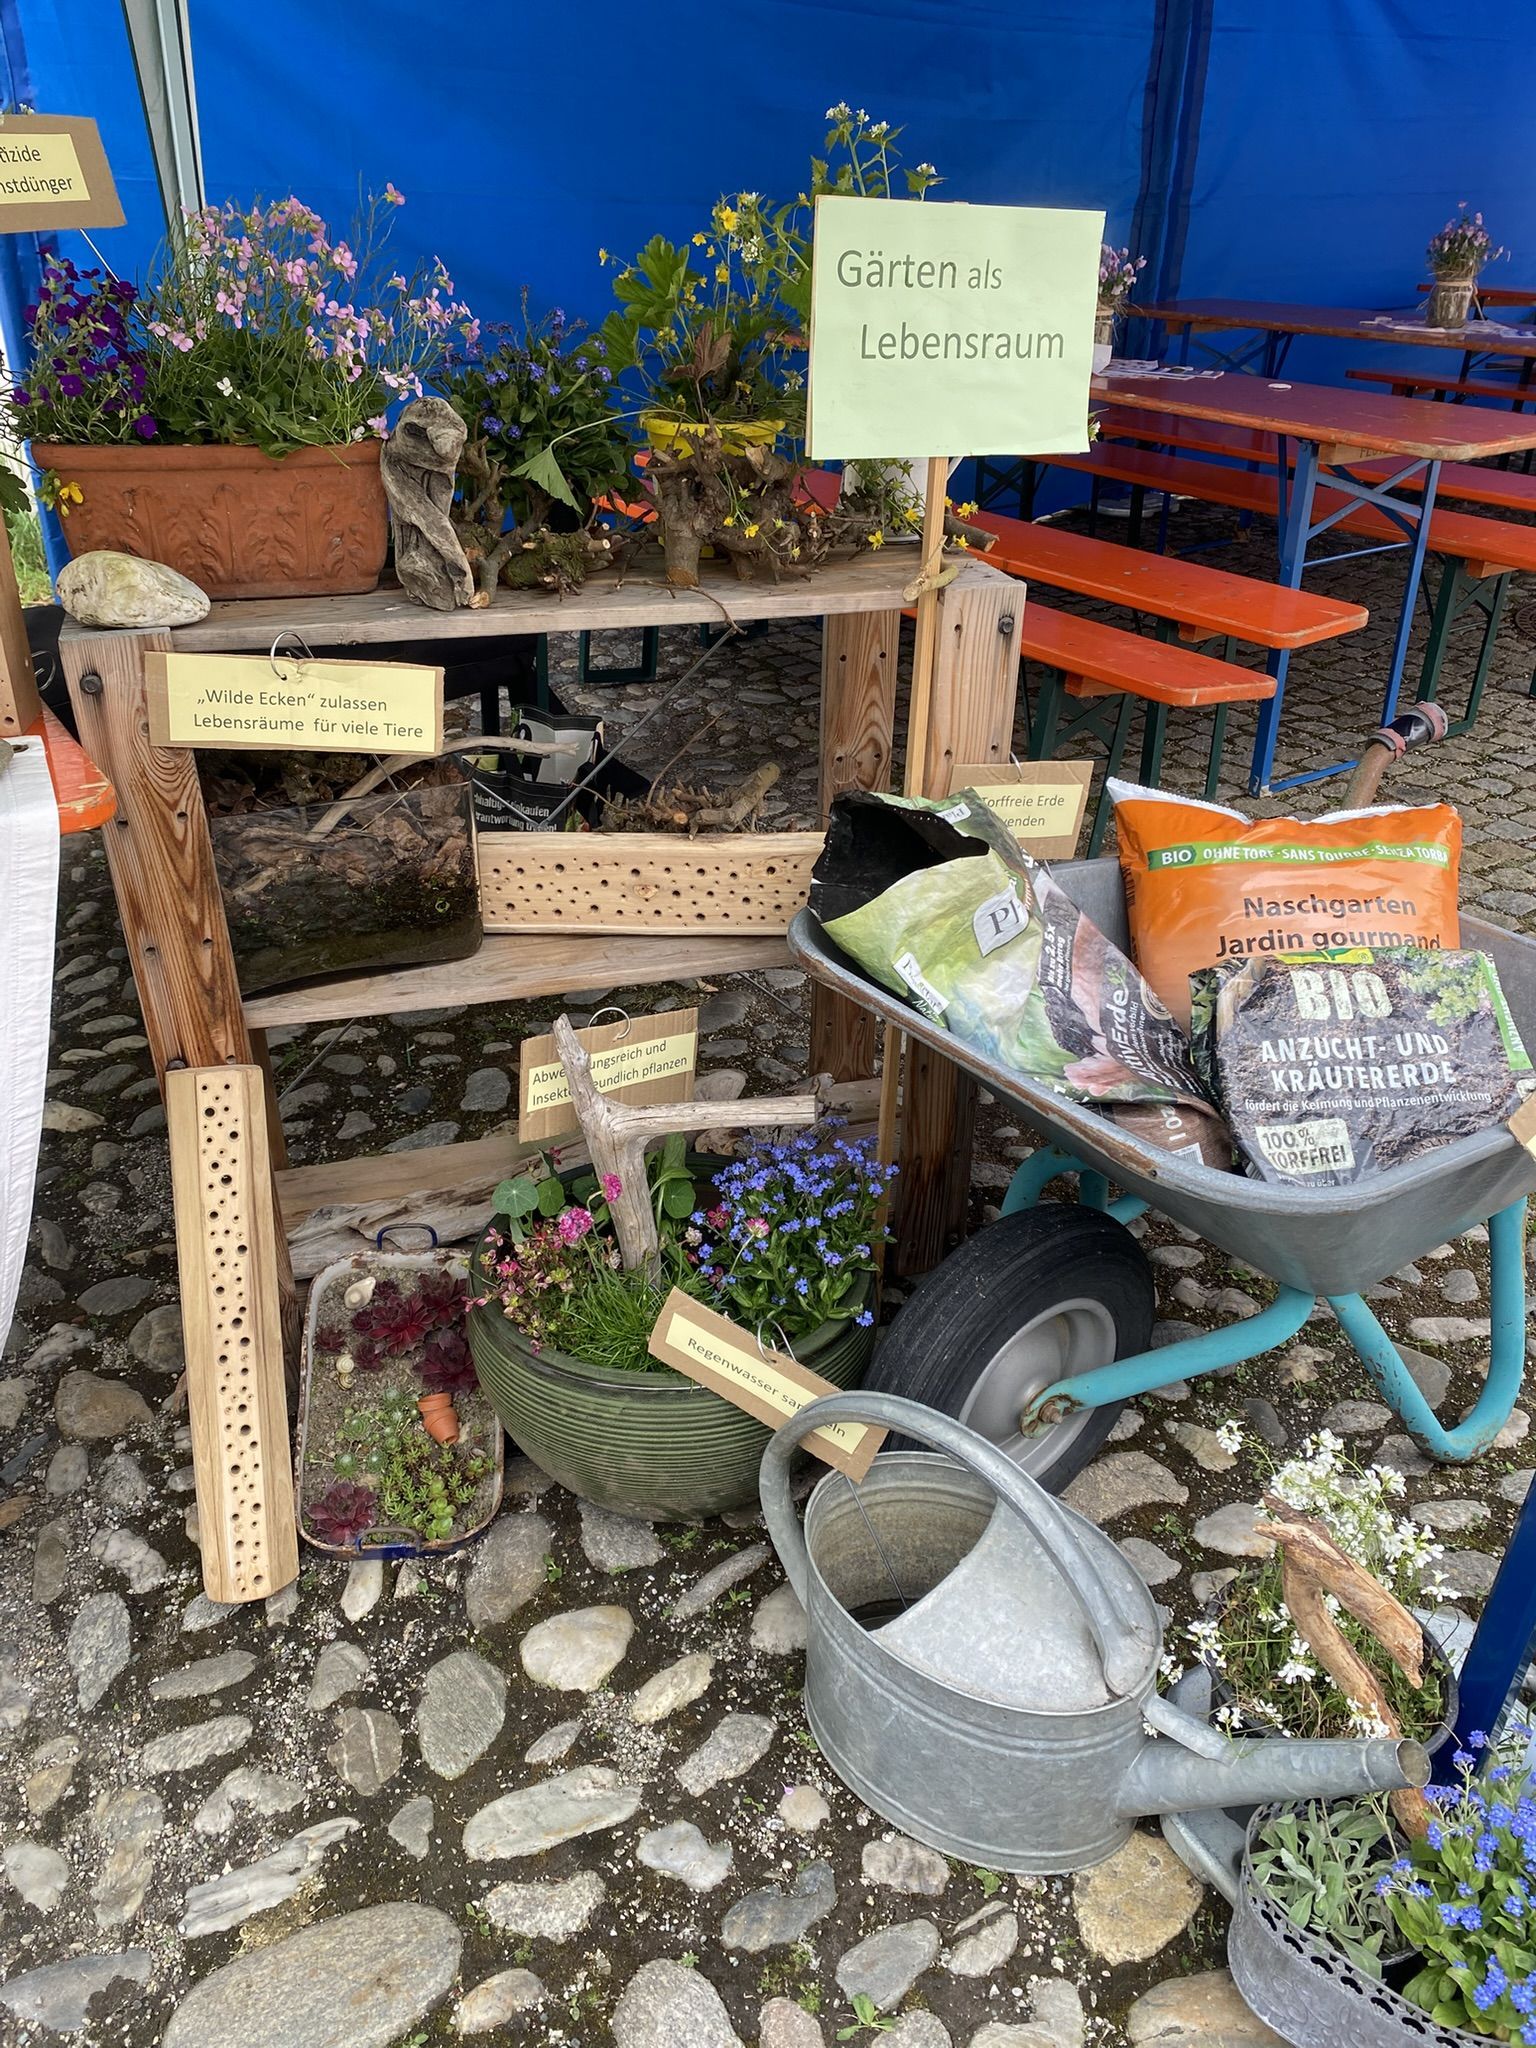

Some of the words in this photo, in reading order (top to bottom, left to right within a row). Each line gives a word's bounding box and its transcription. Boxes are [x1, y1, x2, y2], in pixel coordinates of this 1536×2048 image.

[837, 250, 957, 289] Gärten
[967, 258, 1002, 290] als
[860, 322, 1064, 360] Lebensraum
[197, 688, 253, 705] „Wilde
[259, 691, 315, 707] Ecken“
[320, 695, 387, 712] zulassen
[194, 713, 305, 731] Lebensräume
[314, 718, 337, 733] für
[341, 720, 379, 736] viele
[384, 723, 423, 738] Tiere
[1037, 794, 1065, 807] Erde
[1162, 849, 1192, 865] BIO
[1203, 846, 1240, 860] OHNE
[1243, 847, 1274, 860] TORF
[1282, 848, 1315, 861] SANS
[1415, 847, 1448, 863] TORBA
[1243, 894, 1416, 919] Naschgarten
[1044, 922, 1056, 957] 2,5x
[1216, 929, 1304, 958] Jardin
[1311, 930, 1440, 950] gourmand
[1290, 970, 1393, 1020] BIO
[1261, 1035, 1386, 1063] ANZUCHT-
[1395, 1032, 1449, 1057] UND
[532, 1047, 642, 1085] Abweungsreich
[645, 1040, 667, 1056] und
[641, 1056, 687, 1079] pflanzen
[1270, 1060, 1456, 1092] KRÄUTERERDE
[1245, 1098, 1280, 1112] fördert
[1282, 1100, 1299, 1111] die
[1302, 1099, 1353, 1111] Keimung
[1354, 1097, 1375, 1109] und
[1376, 1089, 1492, 1108] Pflanzenentwicklung
[1268, 1145, 1347, 1169] TORFFREI
[687, 1337, 779, 1395] Regenwasser
